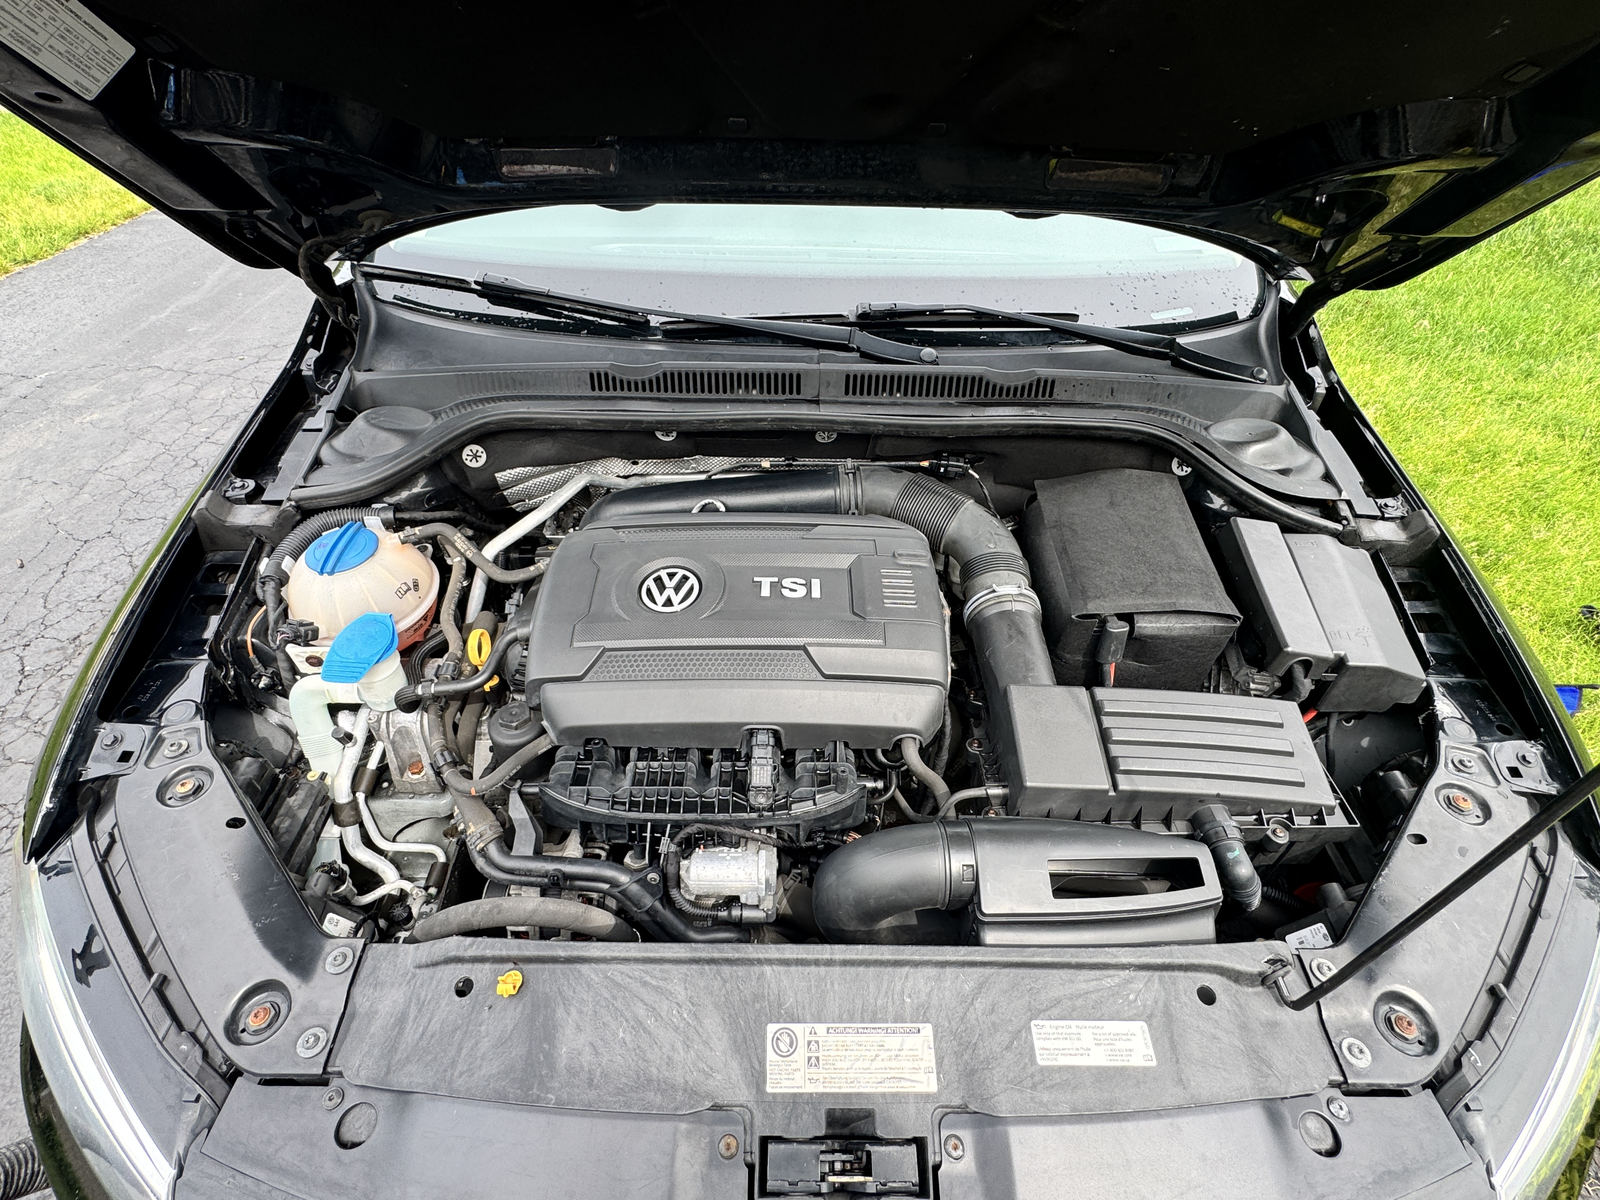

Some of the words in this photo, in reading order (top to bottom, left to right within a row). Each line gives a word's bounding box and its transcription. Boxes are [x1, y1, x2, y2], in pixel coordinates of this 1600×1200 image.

[65, 5, 82, 20] CONTROL
[83, 20, 108, 40] INFORMATION
[641, 567, 700, 613] VW
[753, 576, 822, 599] TSI
